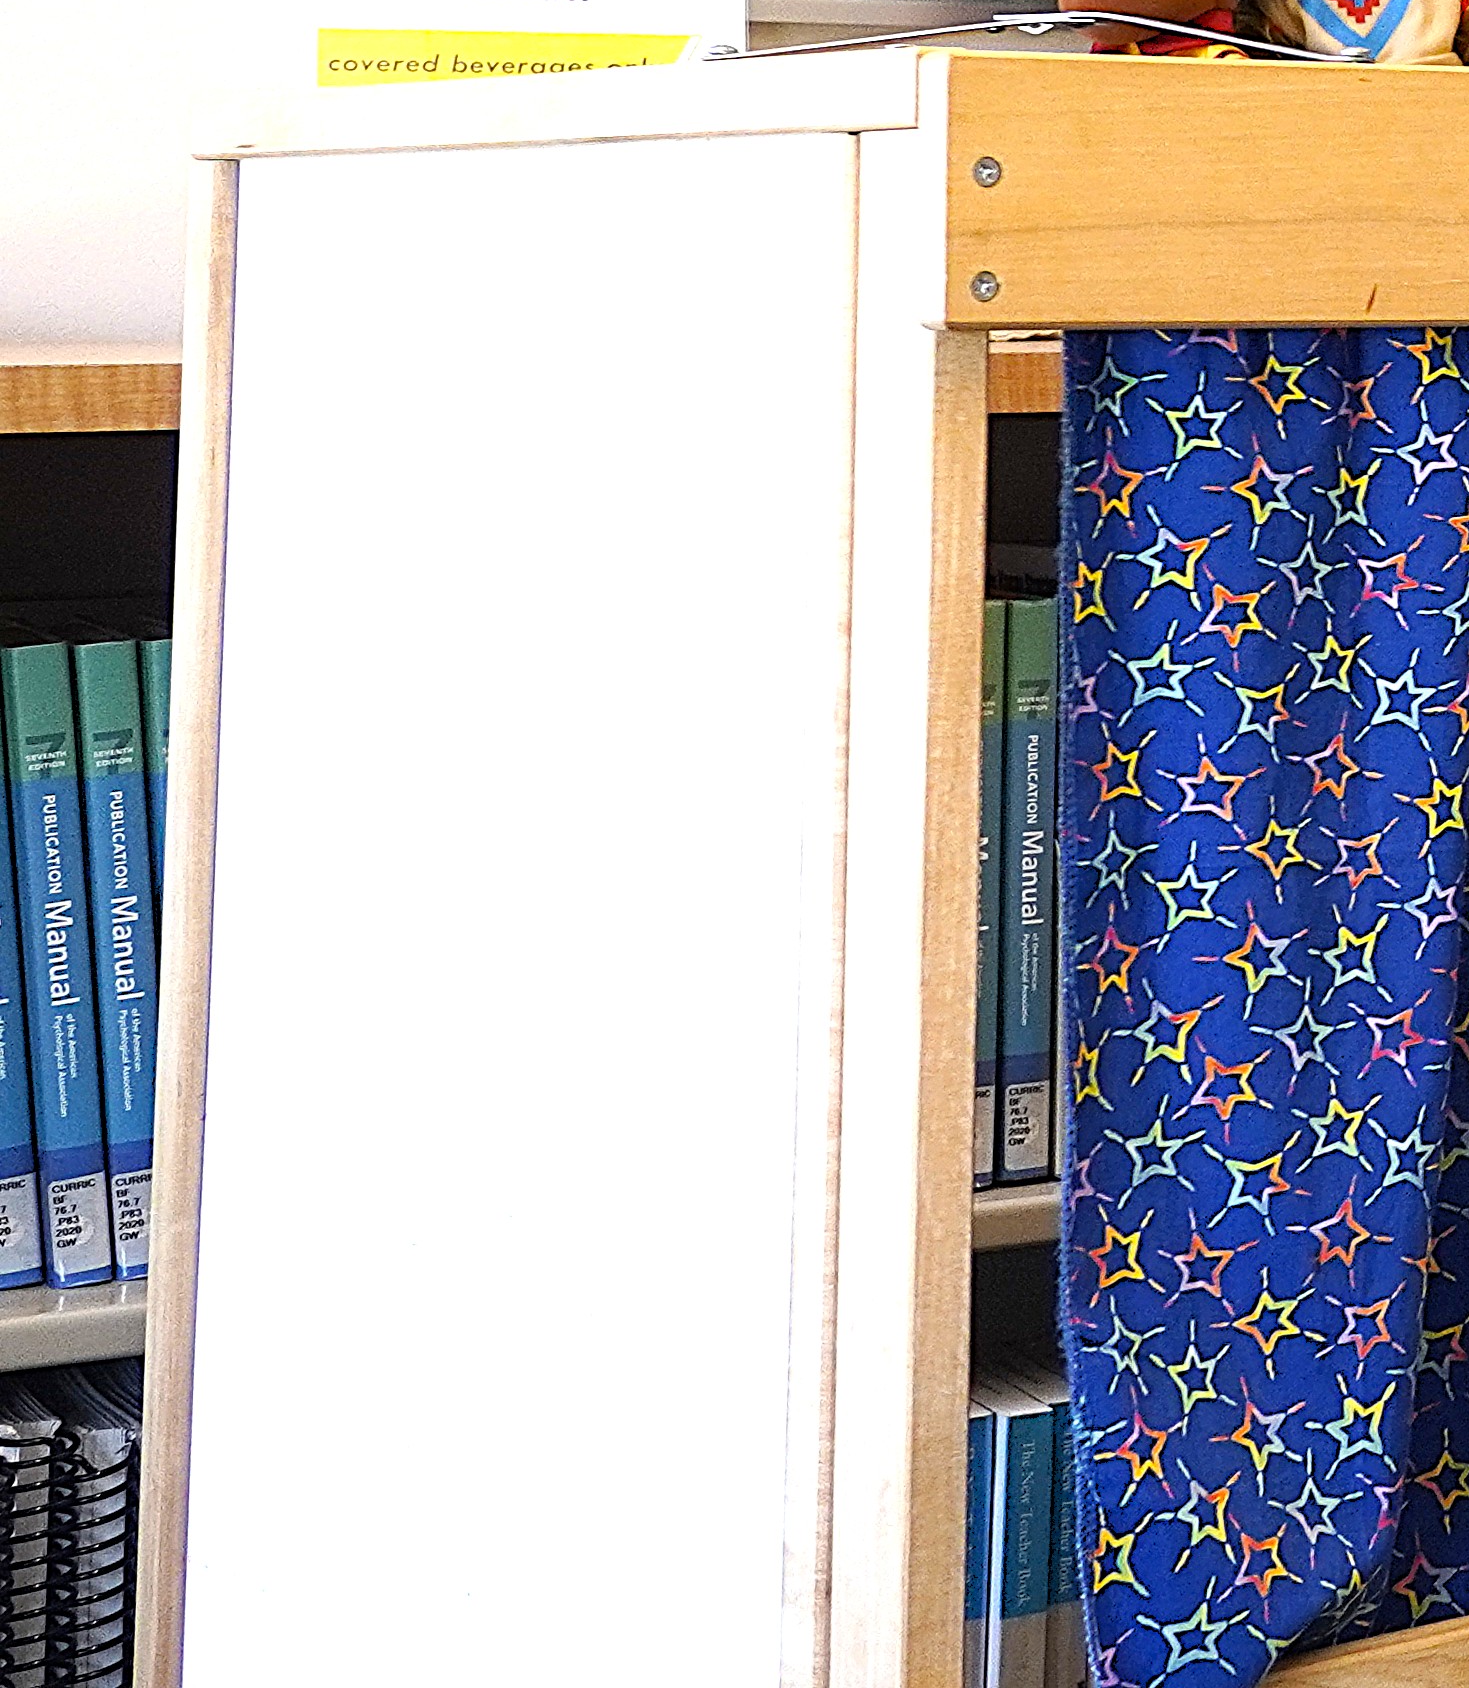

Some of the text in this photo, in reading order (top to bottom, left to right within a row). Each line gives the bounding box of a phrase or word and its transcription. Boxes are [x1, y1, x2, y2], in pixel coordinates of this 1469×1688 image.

[328, 54, 440, 74] covered
[1027, 734, 1039, 824] PUBLICATION
[42, 793, 80, 1006] PUBLICATION Manual
[109, 790, 146, 1001] PUBLICATION Manual
[1021, 830, 1044, 925] Manual
[51, 1178, 96, 1193] CURRIC
